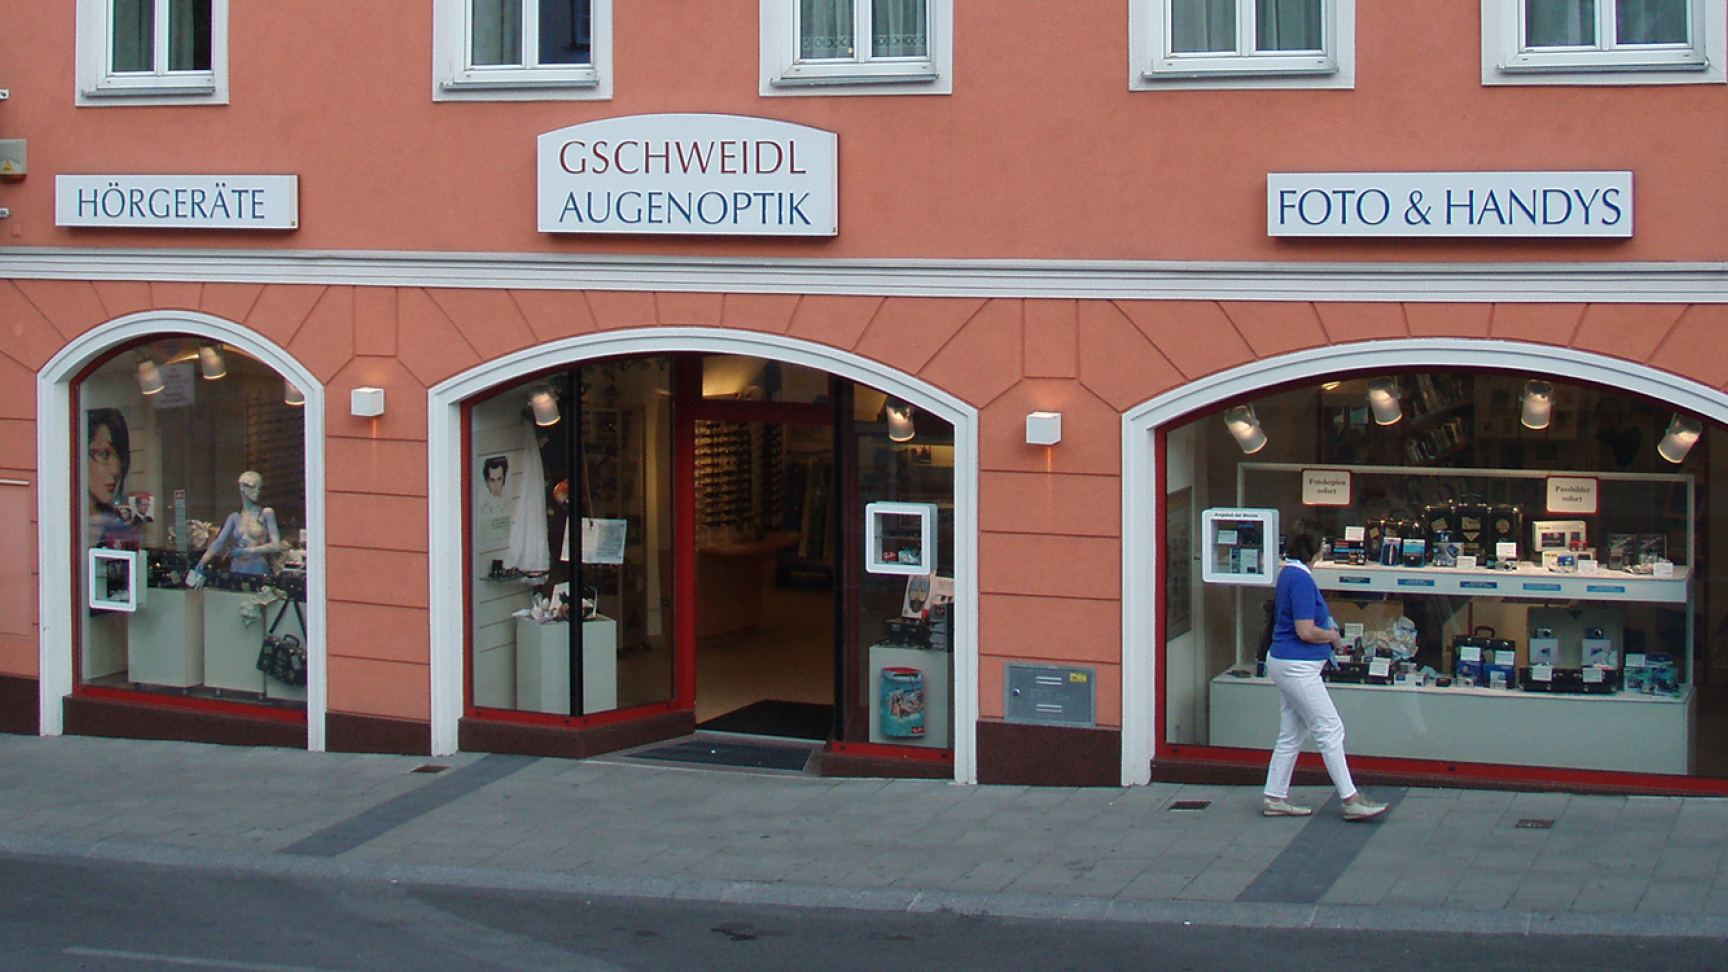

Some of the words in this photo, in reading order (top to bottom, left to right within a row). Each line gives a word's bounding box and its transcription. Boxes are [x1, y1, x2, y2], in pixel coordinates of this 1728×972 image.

[559, 140, 806, 175] GSCHWEIDL
[78, 182, 265, 219] HÖRGERÄTE
[559, 191, 812, 225] AUGENOPTIK
[1279, 188, 1390, 225] FOTO
[1404, 189, 1432, 225] &
[1446, 187, 1622, 226] HANDYS
